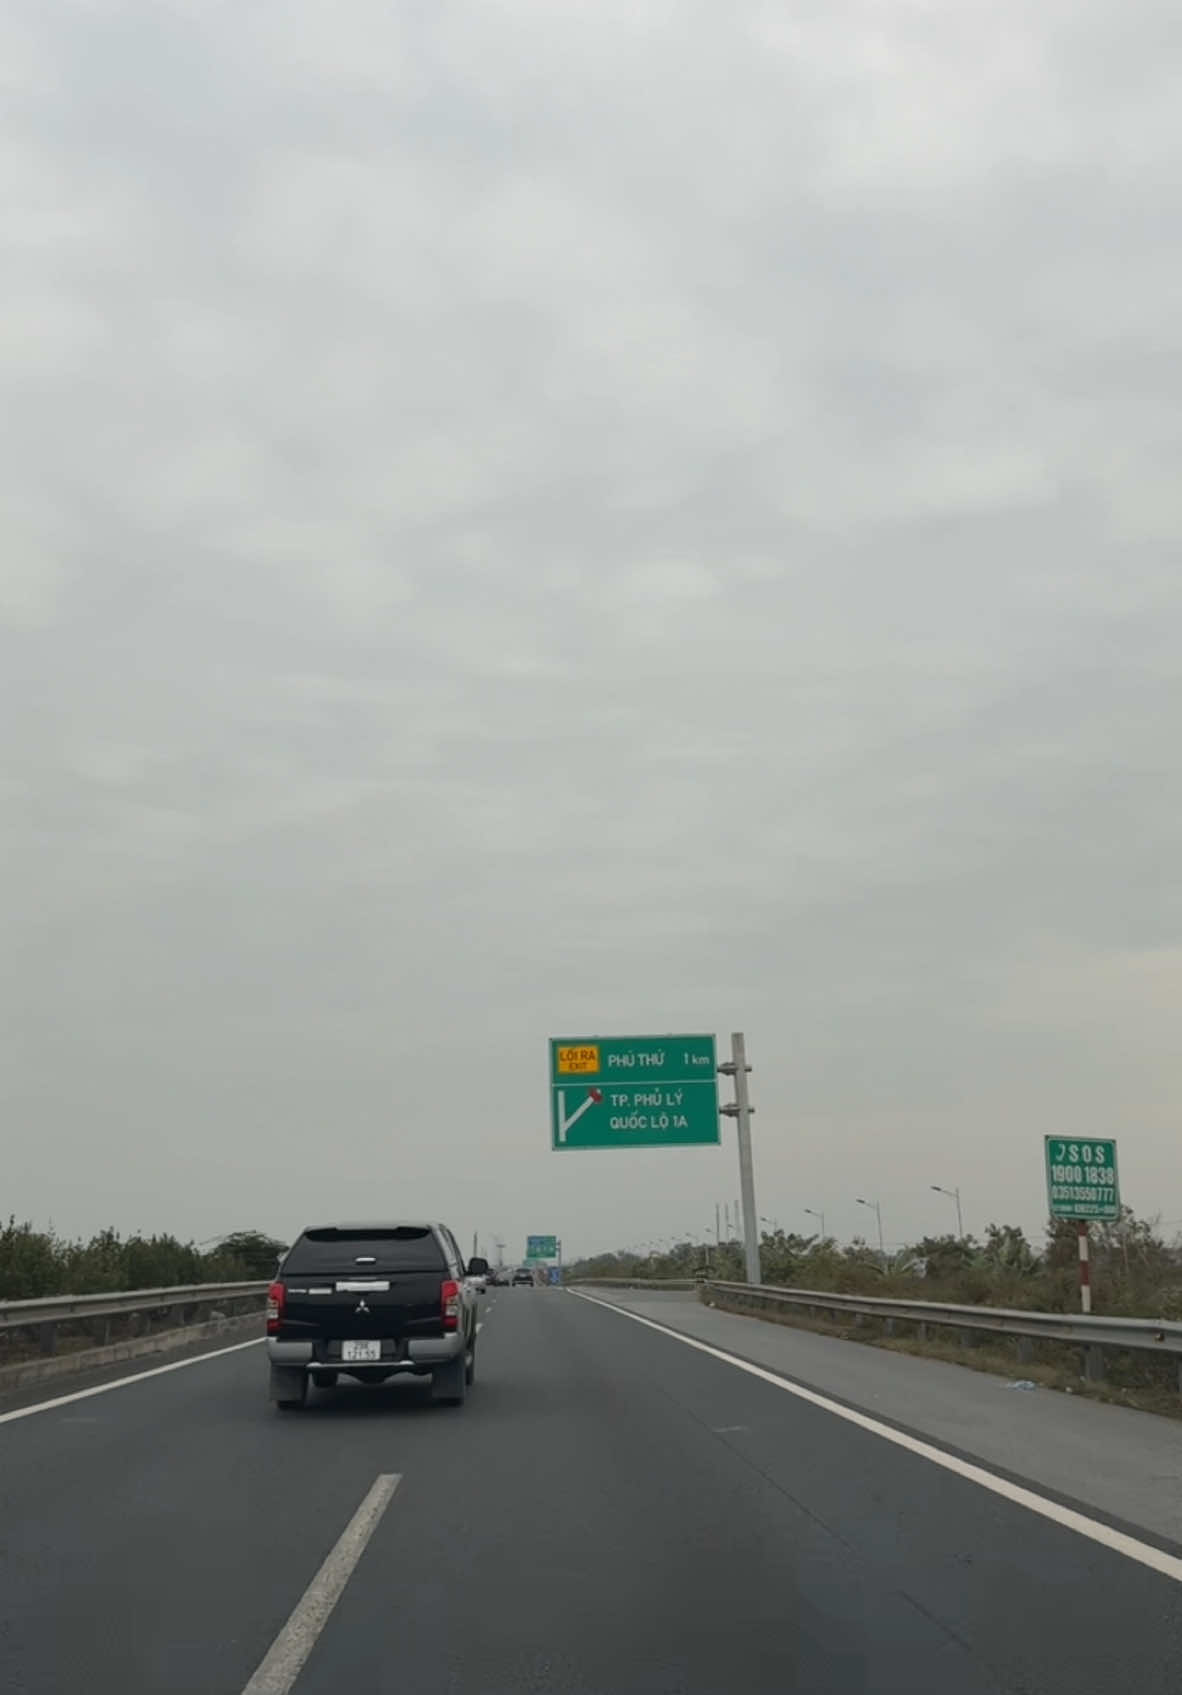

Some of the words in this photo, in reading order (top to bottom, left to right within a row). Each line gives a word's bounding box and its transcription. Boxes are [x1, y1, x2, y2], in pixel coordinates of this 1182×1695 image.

[580, 1048, 596, 1061] RA
[684, 1052, 689, 1064] 1
[691, 1054, 710, 1064] km
[610, 1094, 631, 1107] TP.
[634, 1088, 662, 1106] PHỦ
[666, 1088, 683, 1105] LÝ
[610, 1110, 648, 1128] QUỐC
[651, 1112, 669, 1131] LỘ
[673, 1115, 688, 1128] 1A
[1052, 1165, 1082, 1183] 1900
